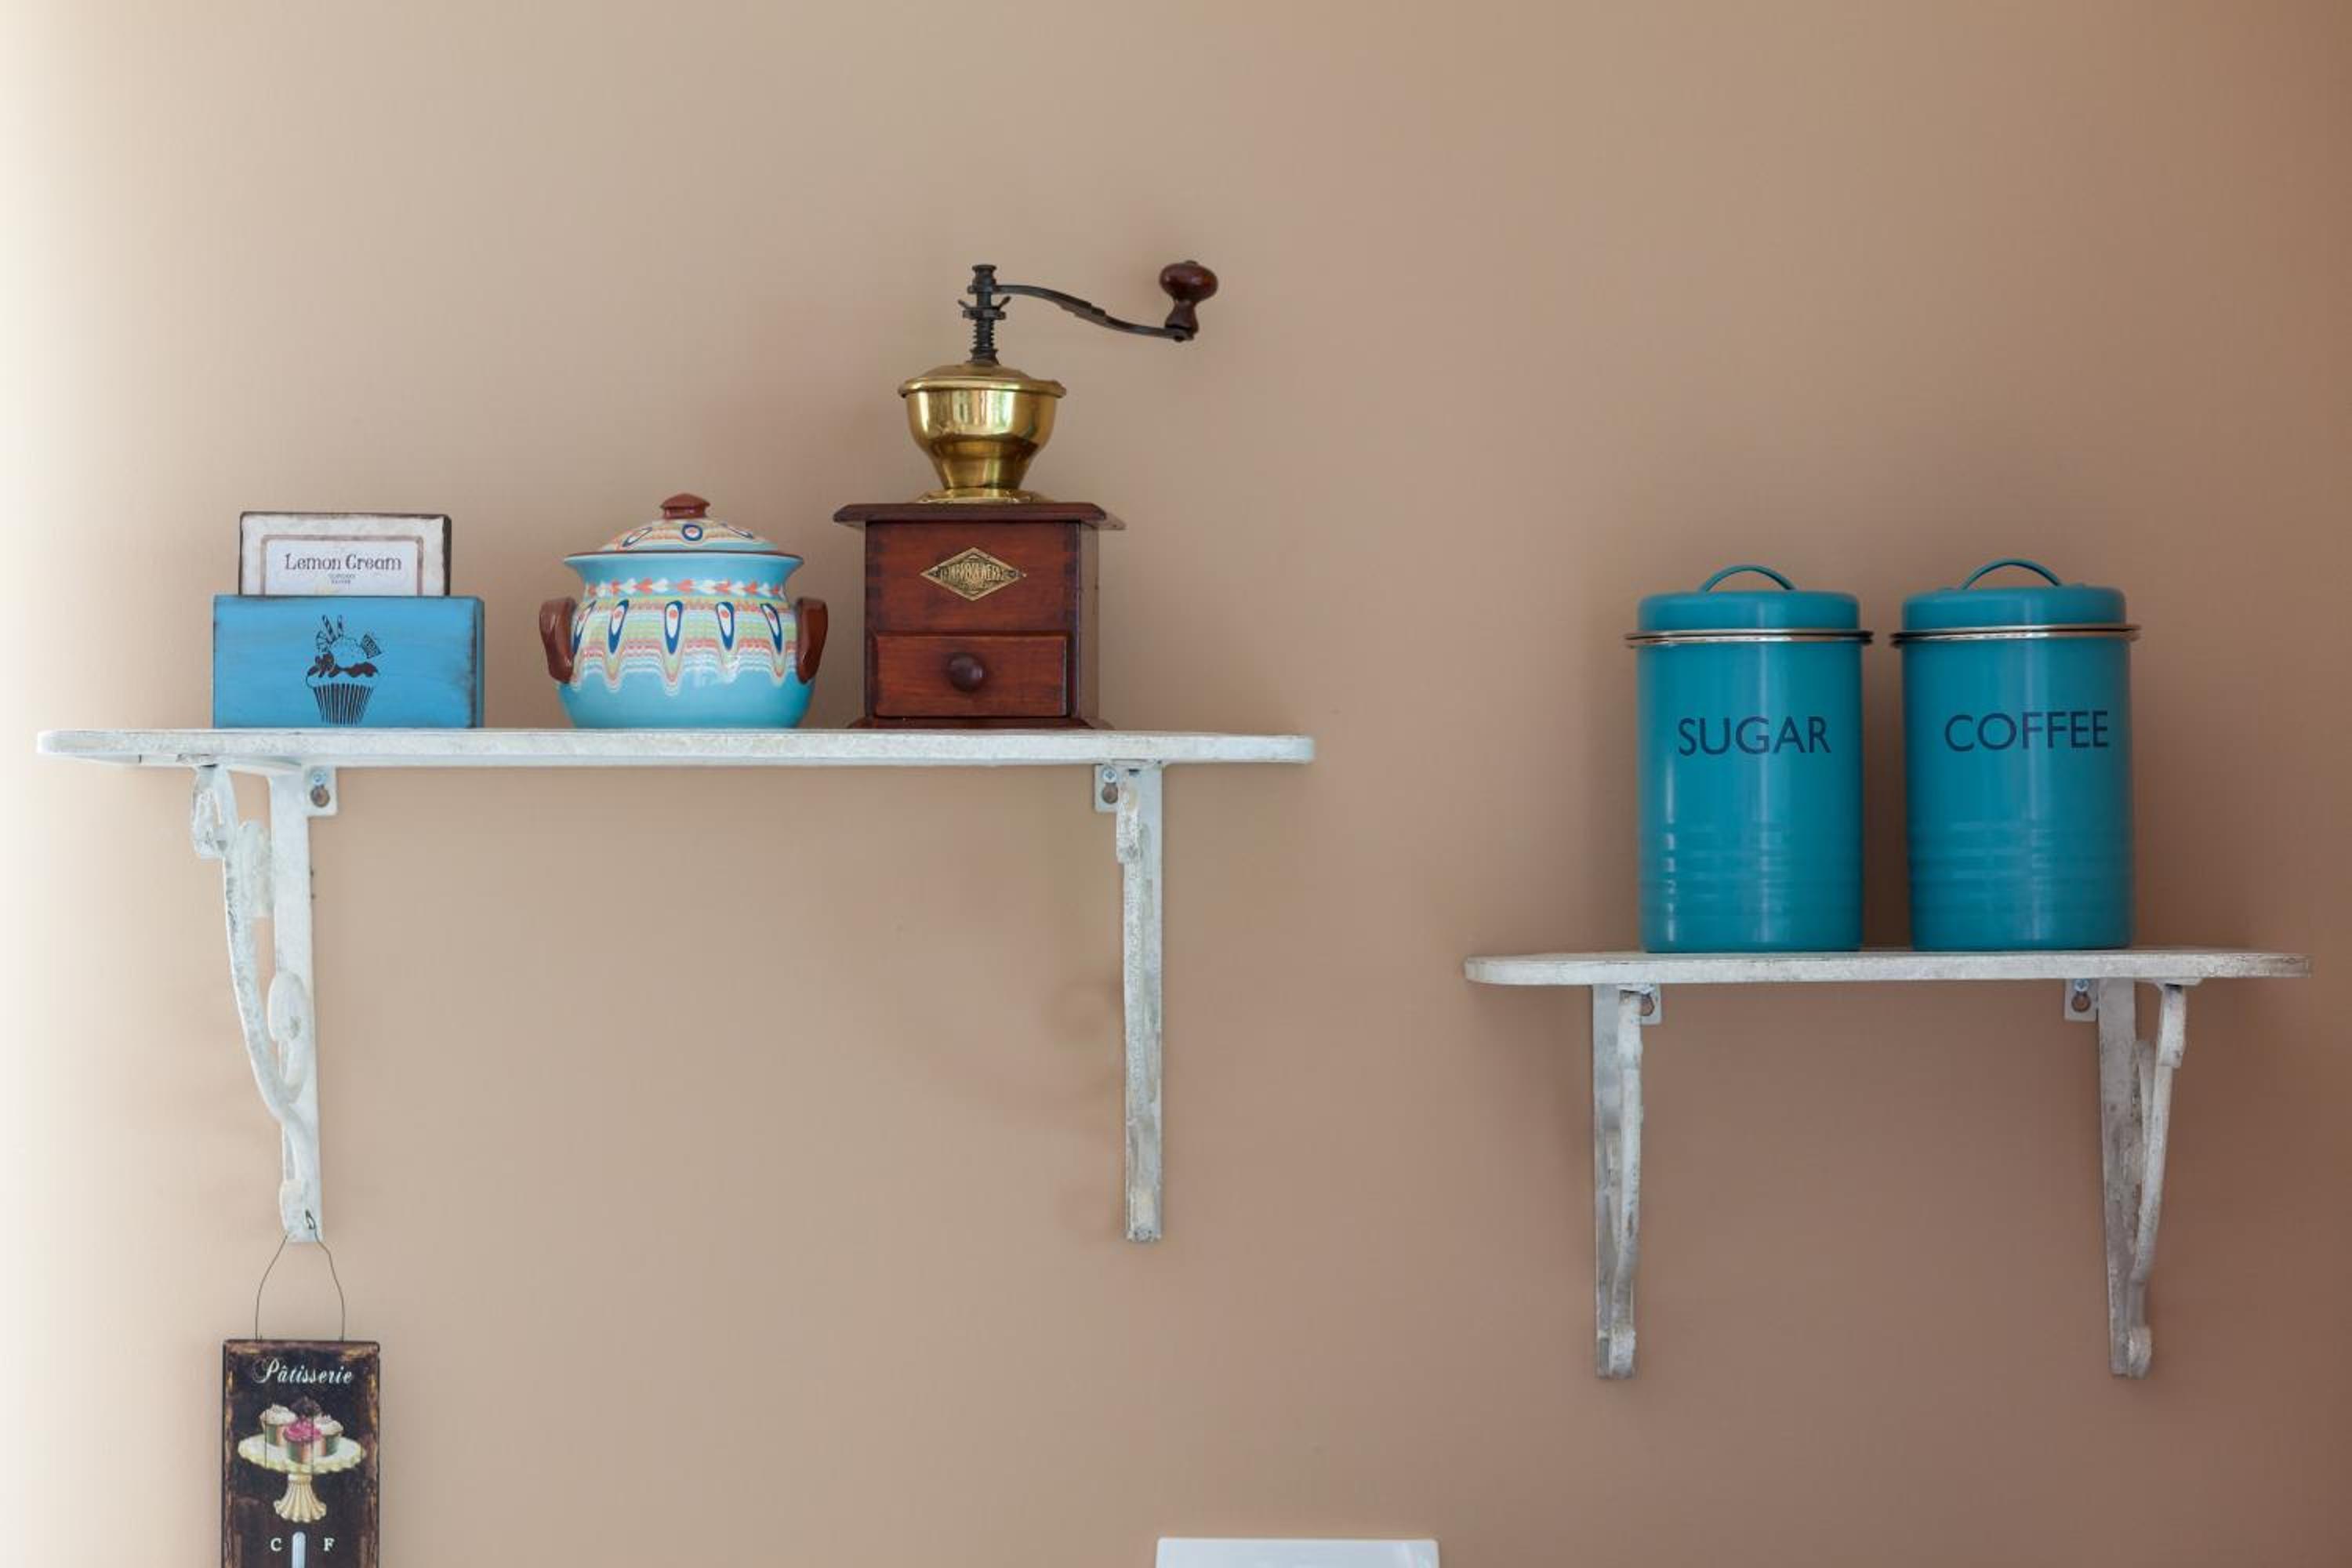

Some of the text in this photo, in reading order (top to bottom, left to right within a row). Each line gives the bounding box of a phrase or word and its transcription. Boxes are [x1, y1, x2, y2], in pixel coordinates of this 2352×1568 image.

[285, 553, 401, 571] Lemon Cream
[1678, 715, 1832, 757] SUGAR
[1944, 710, 2109, 753] COFFEE
[252, 1358, 353, 1385] Pâtisserie
[270, 1537, 335, 1552] C F
